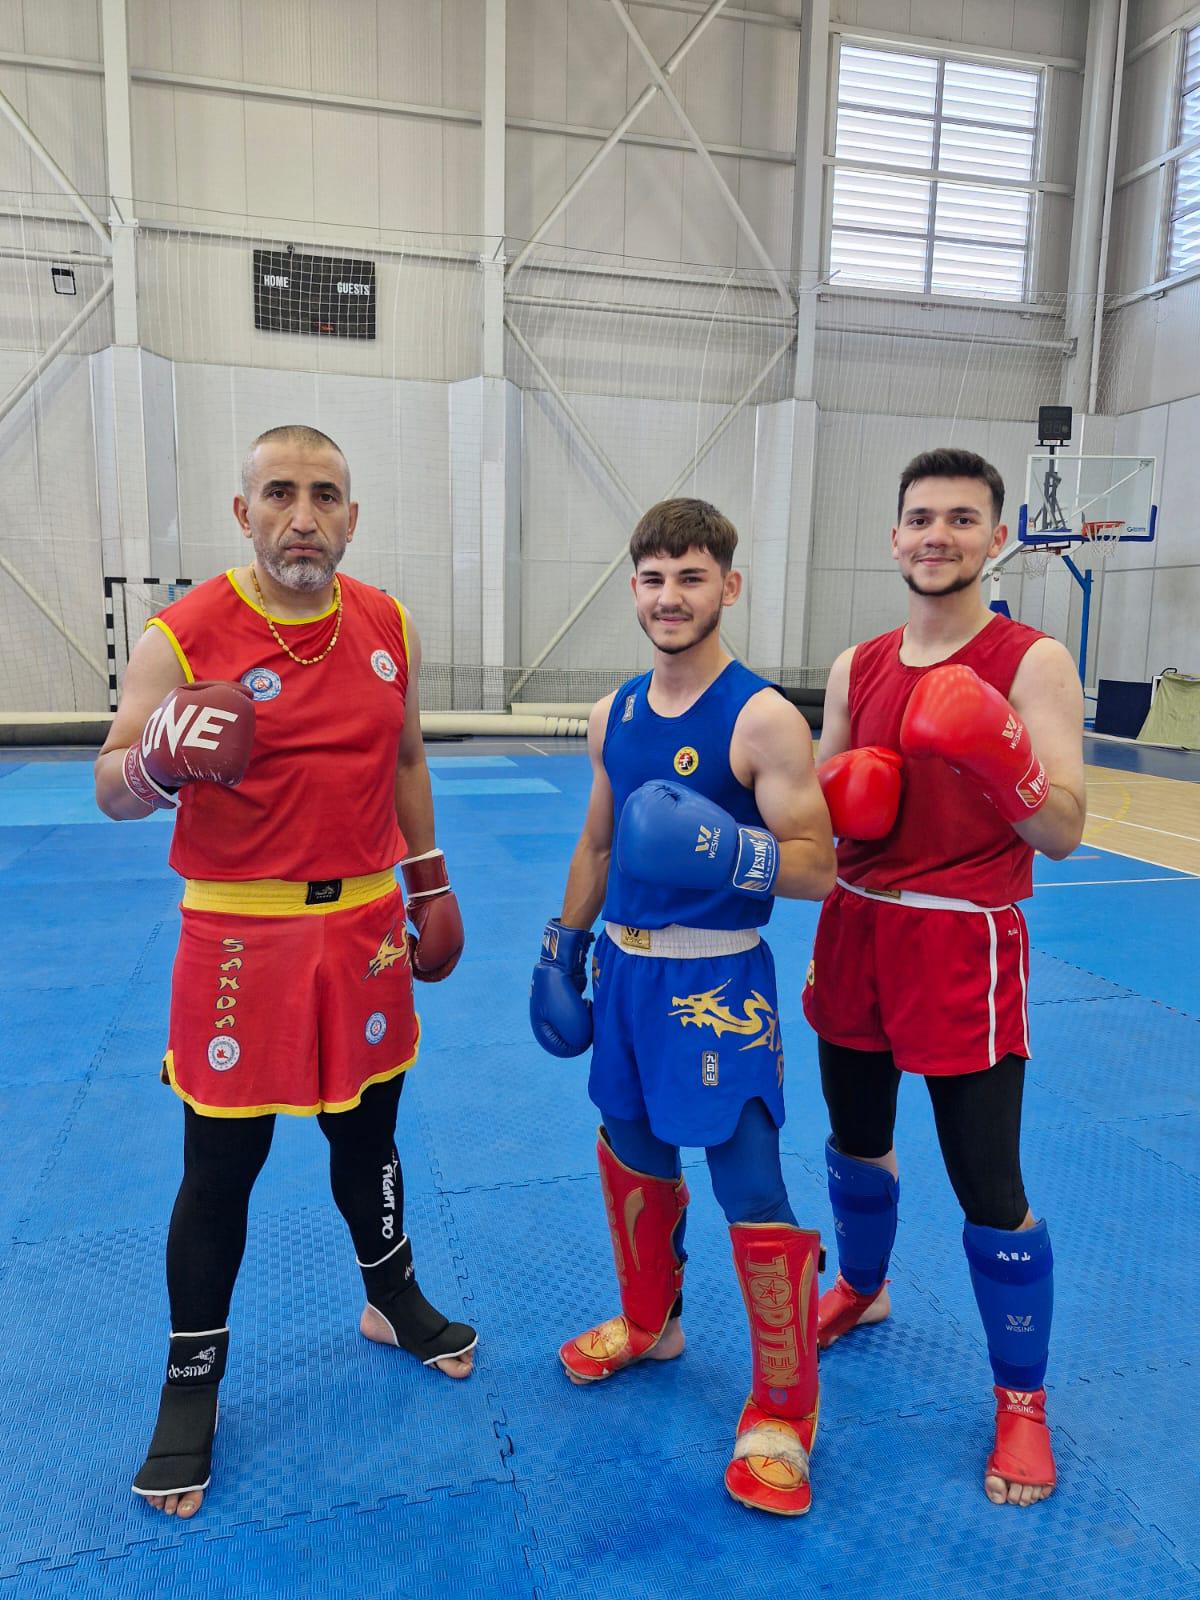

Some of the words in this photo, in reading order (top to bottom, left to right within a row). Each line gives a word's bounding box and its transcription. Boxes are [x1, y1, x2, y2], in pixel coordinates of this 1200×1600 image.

[263, 274, 289, 288] HOME
[336, 281, 370, 295] GUESTS
[142, 696, 239, 759] ONE
[708, 827, 721, 859] WESING
[744, 838, 768, 879] WESING
[214, 938, 244, 1029] SANDA
[706, 1054, 715, 1081] 九日山
[382, 1163, 395, 1210] FIGHT
[382, 1214, 394, 1239] DO
[1005, 1324, 1035, 1333] WESING
[1007, 1404, 1034, 1414] WESING
